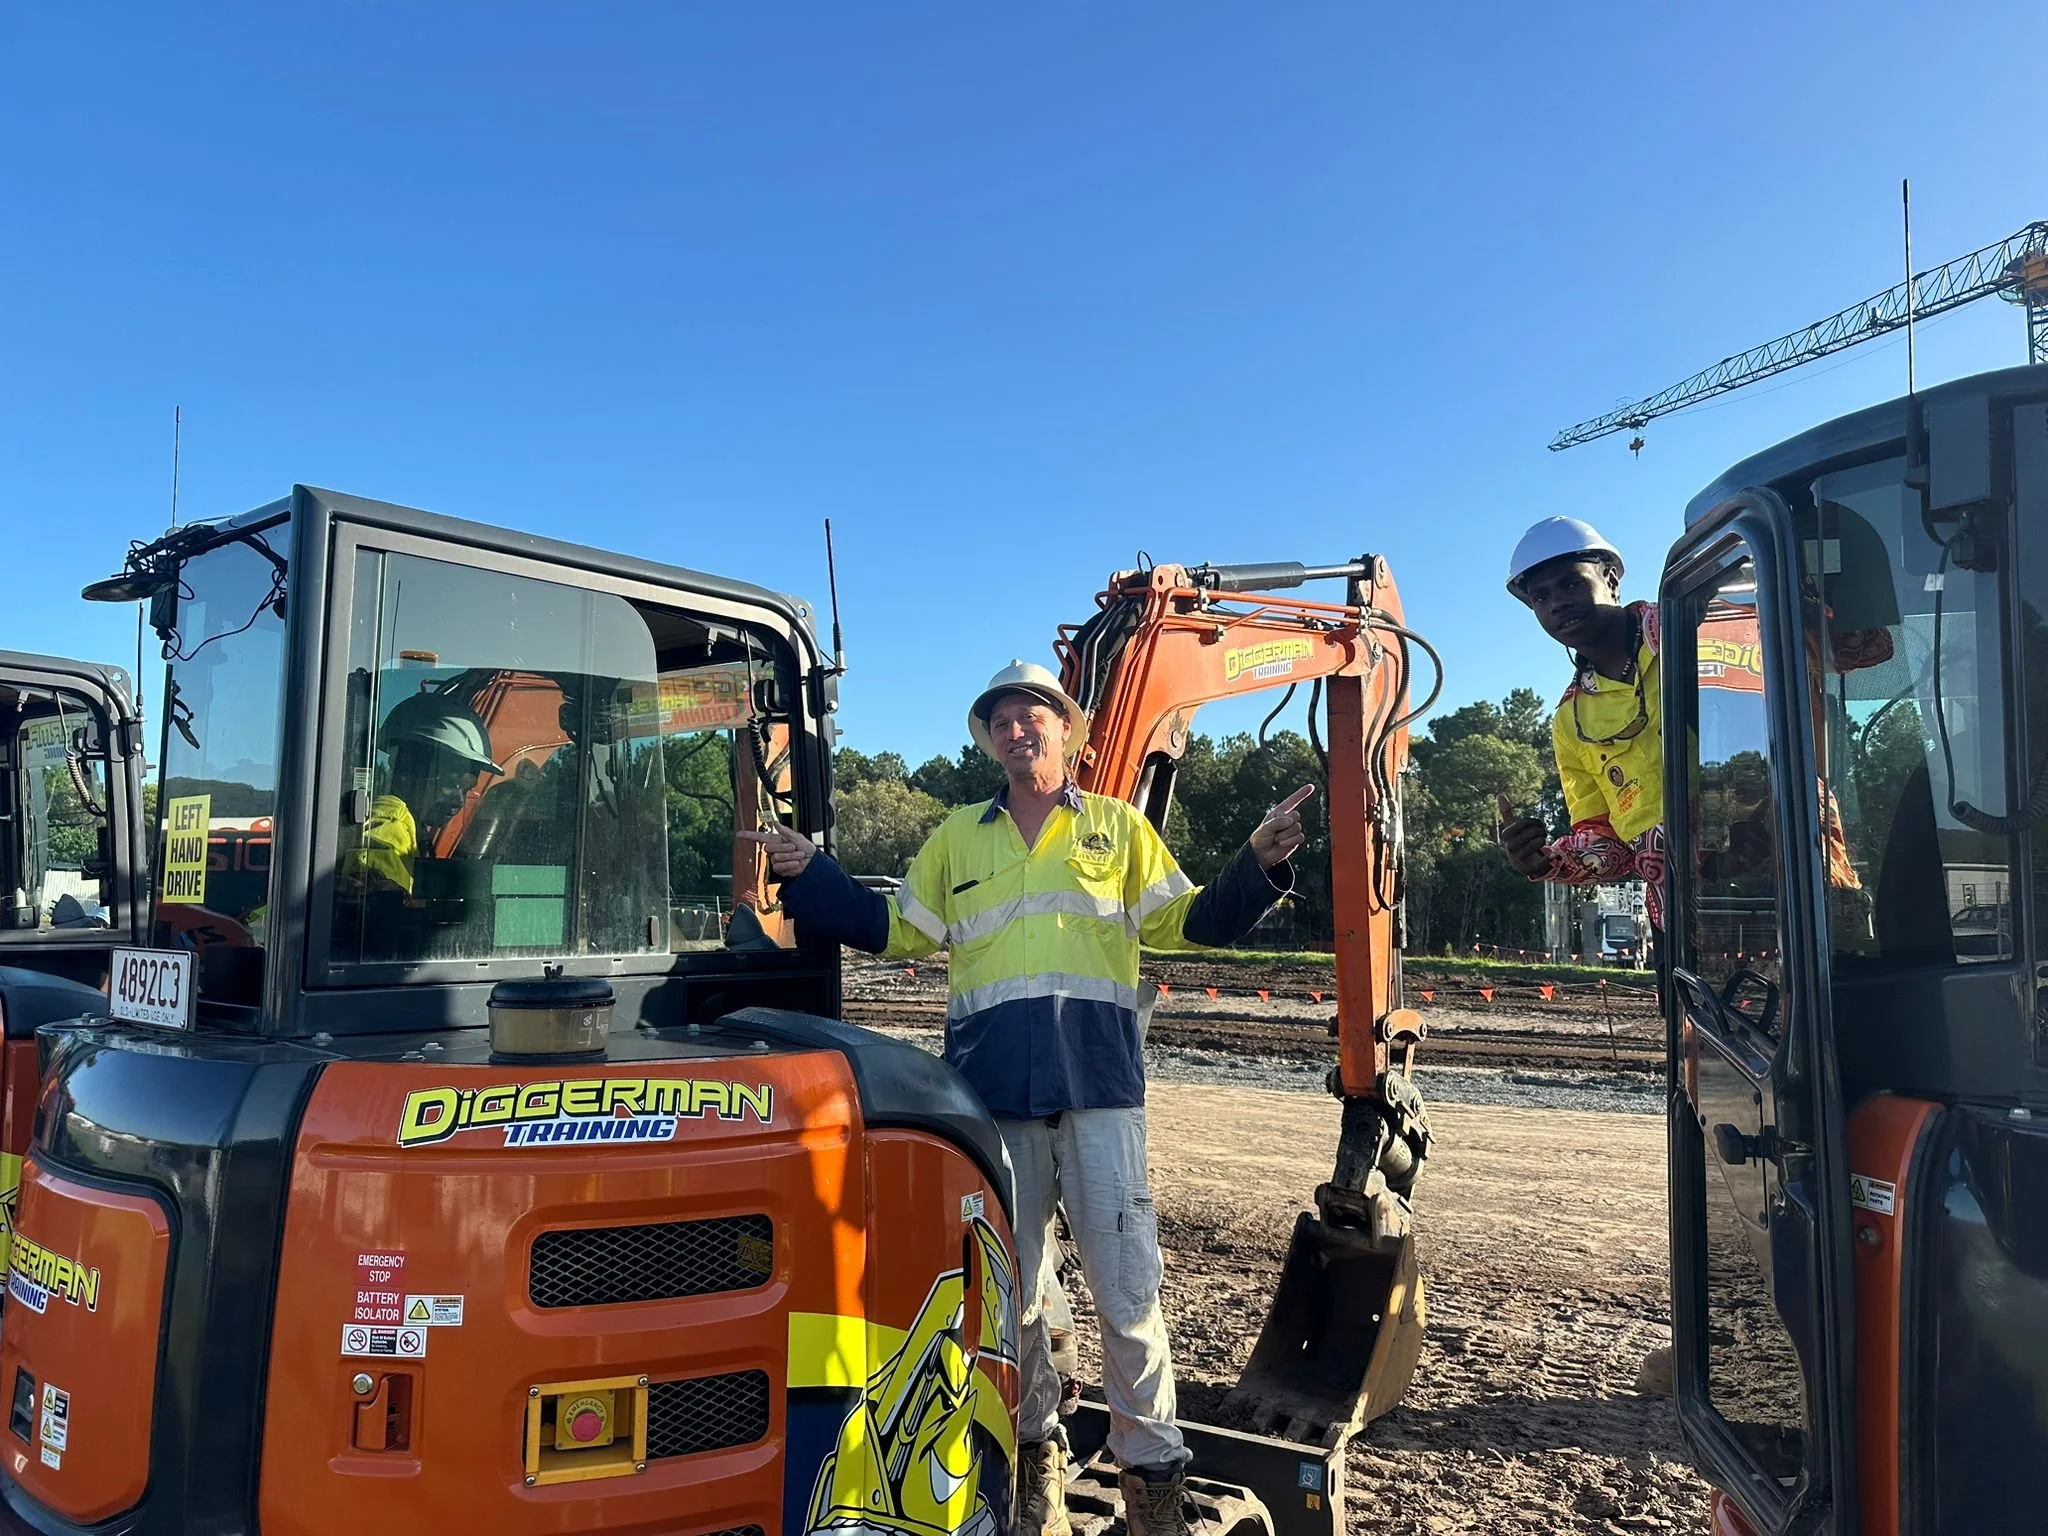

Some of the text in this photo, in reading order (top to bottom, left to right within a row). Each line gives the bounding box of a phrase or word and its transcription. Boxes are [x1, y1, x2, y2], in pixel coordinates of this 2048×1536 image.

[1253, 662, 1291, 678] TRAINING
[174, 803, 203, 831] LEFT
[170, 836, 203, 864] HAND
[166, 870, 202, 897] DRIVE
[119, 957, 181, 1009] 4892C3
[504, 1118, 675, 1144] TRAINING
[358, 1254, 405, 1268] EMERGENCY
[369, 1270, 391, 1282] STOP
[357, 1291, 400, 1304] BATTERY
[354, 1307, 400, 1321] ISOLATOR
[569, 1400, 604, 1417] EMERGENCY
